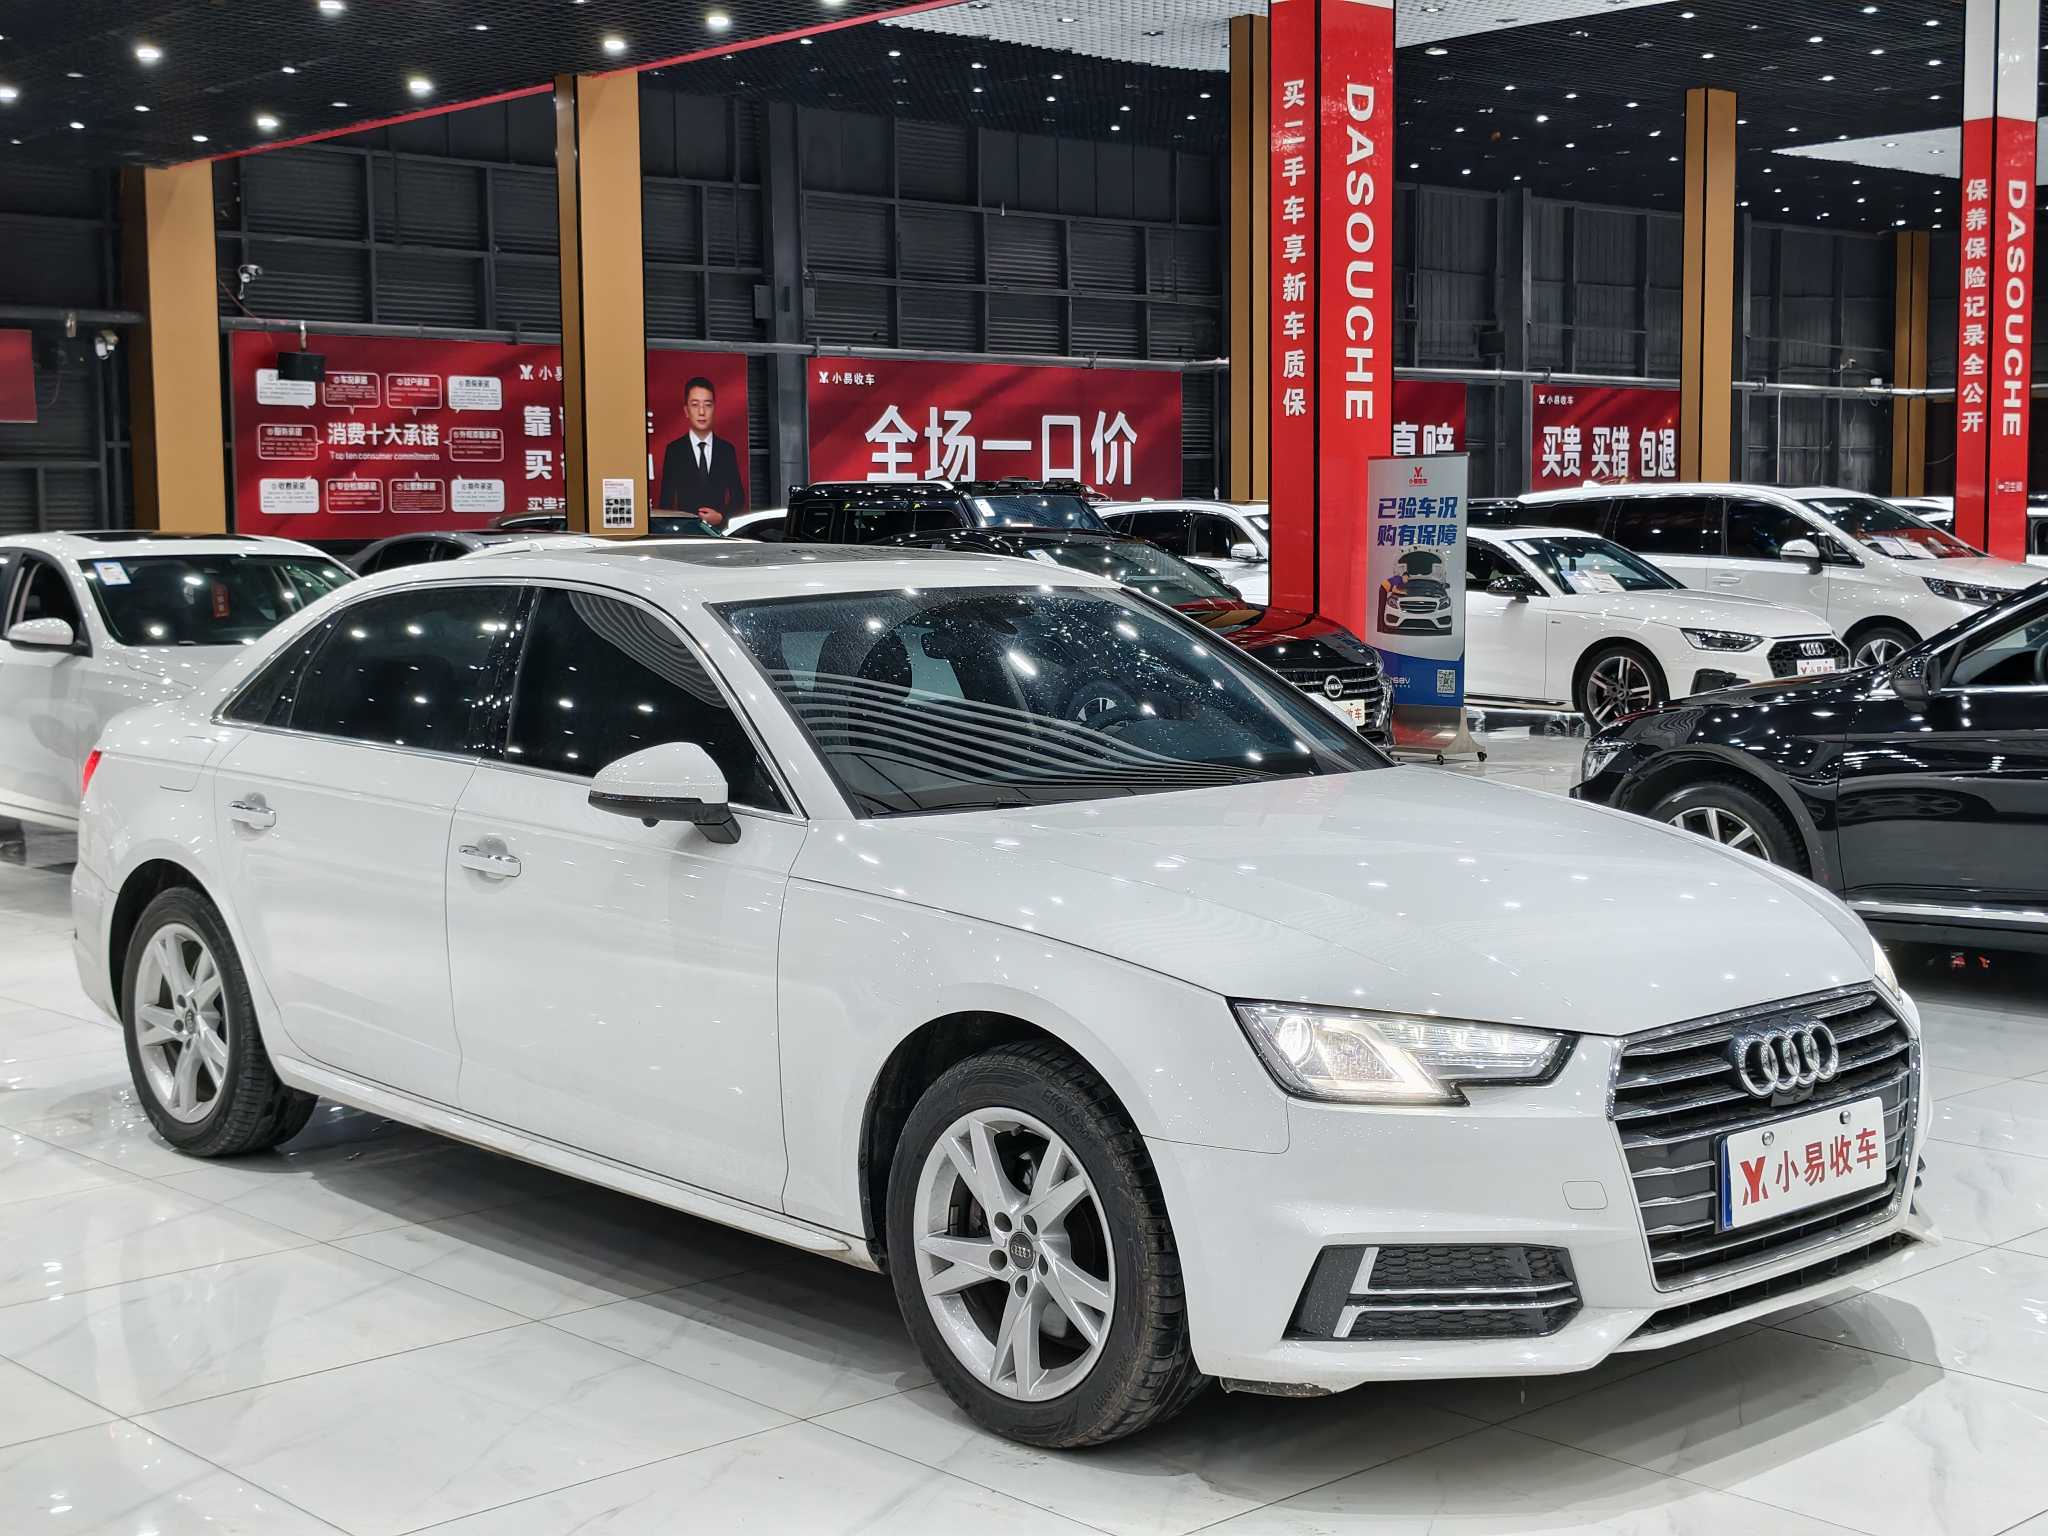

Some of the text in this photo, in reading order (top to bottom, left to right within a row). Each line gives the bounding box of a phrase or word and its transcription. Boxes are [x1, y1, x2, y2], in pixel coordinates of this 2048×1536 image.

[1282, 79, 1307, 417] 买二手车享新车质保
[1345, 82, 1375, 420] DASOUCHE
[1961, 178, 1989, 434] 保养保险记录全公开
[2002, 179, 2027, 436] DASOUCHE
[832, 371, 875, 386] 小易收车
[327, 421, 439, 446] 消费十大承诺
[864, 404, 1138, 486] 全场一口价
[1542, 425, 1676, 478] 买贵 买错 包退
[1376, 524, 1458, 547] 购有保障
[1377, 496, 1458, 519] 已验车况
[1775, 1127, 1879, 1194] 小易收车
